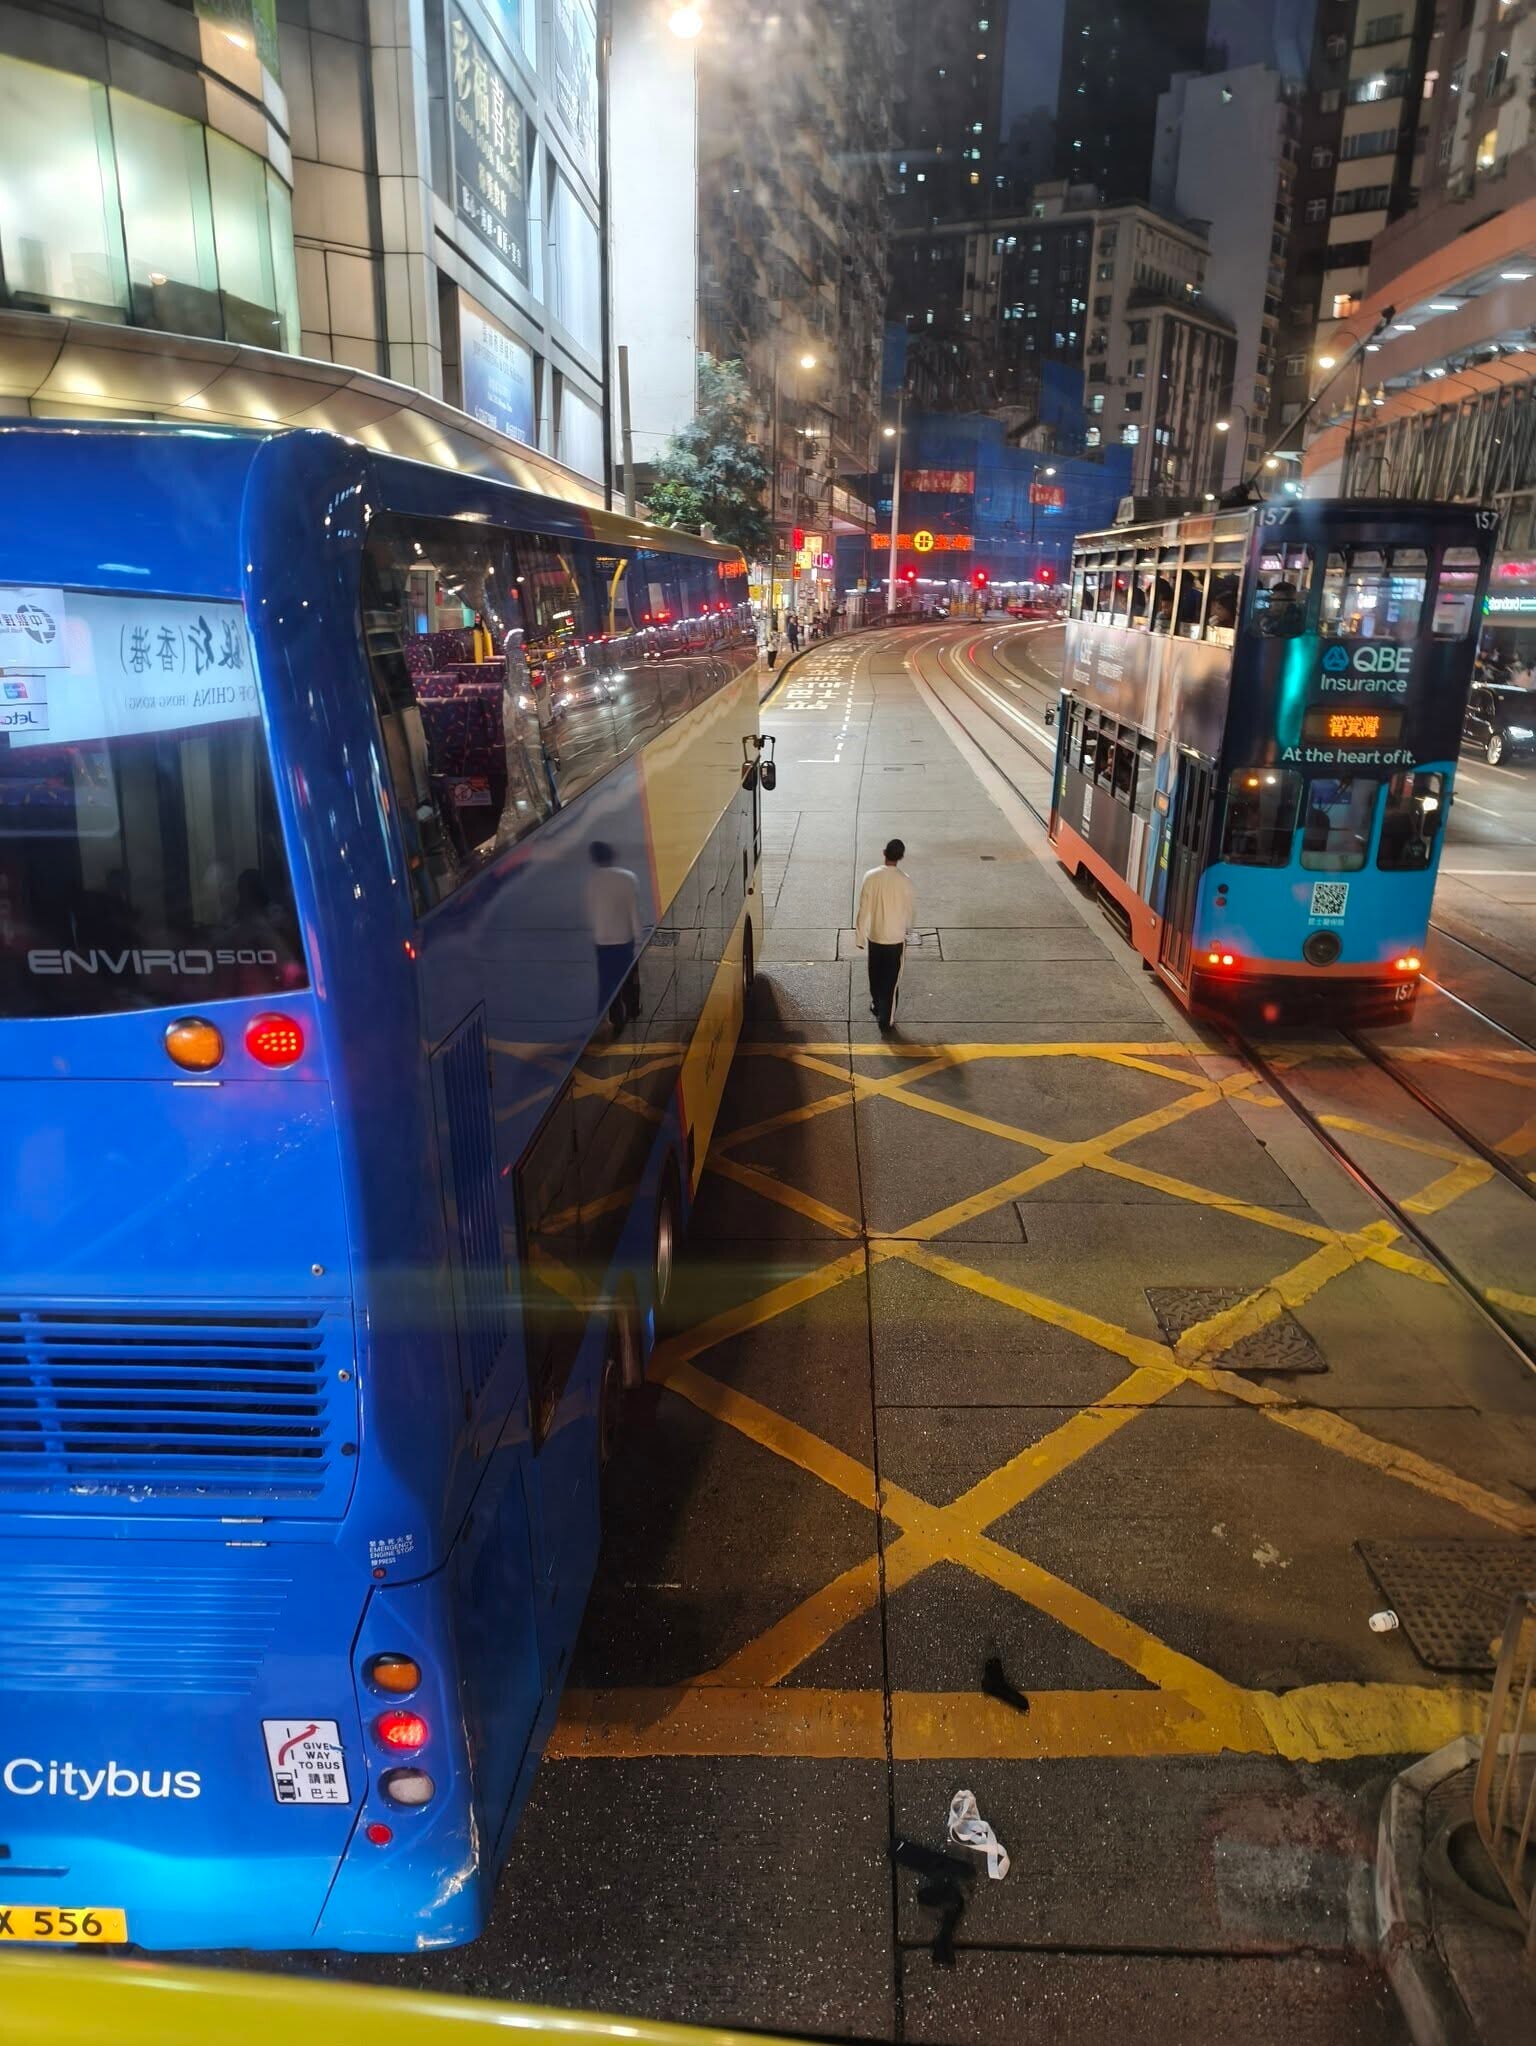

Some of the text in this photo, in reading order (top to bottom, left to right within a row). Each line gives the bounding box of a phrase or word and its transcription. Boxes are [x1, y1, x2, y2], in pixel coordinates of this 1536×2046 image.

[1259, 507, 1292, 527] 157
[1475, 512, 1499, 531] 157
[1353, 647, 1413, 673] QBE
[1320, 674, 1407, 693] Insurance
[1282, 747, 1417, 765] At the heart of it.
[1395, 984, 1415, 1001] 157
[370, 1541, 414, 1553] EMERGENCY
[370, 1546, 414, 1559] ENGINE STOP
[378, 1557, 396, 1565] PRESS
[303, 1742, 329, 1750] GIVE
[306, 1752, 330, 1760] WAY
[3, 1758, 202, 1801] Citybus
[309, 1773, 336, 1784] 請讓
[311, 1788, 338, 1799] 巴士
[34, 1911, 103, 1936] 556
